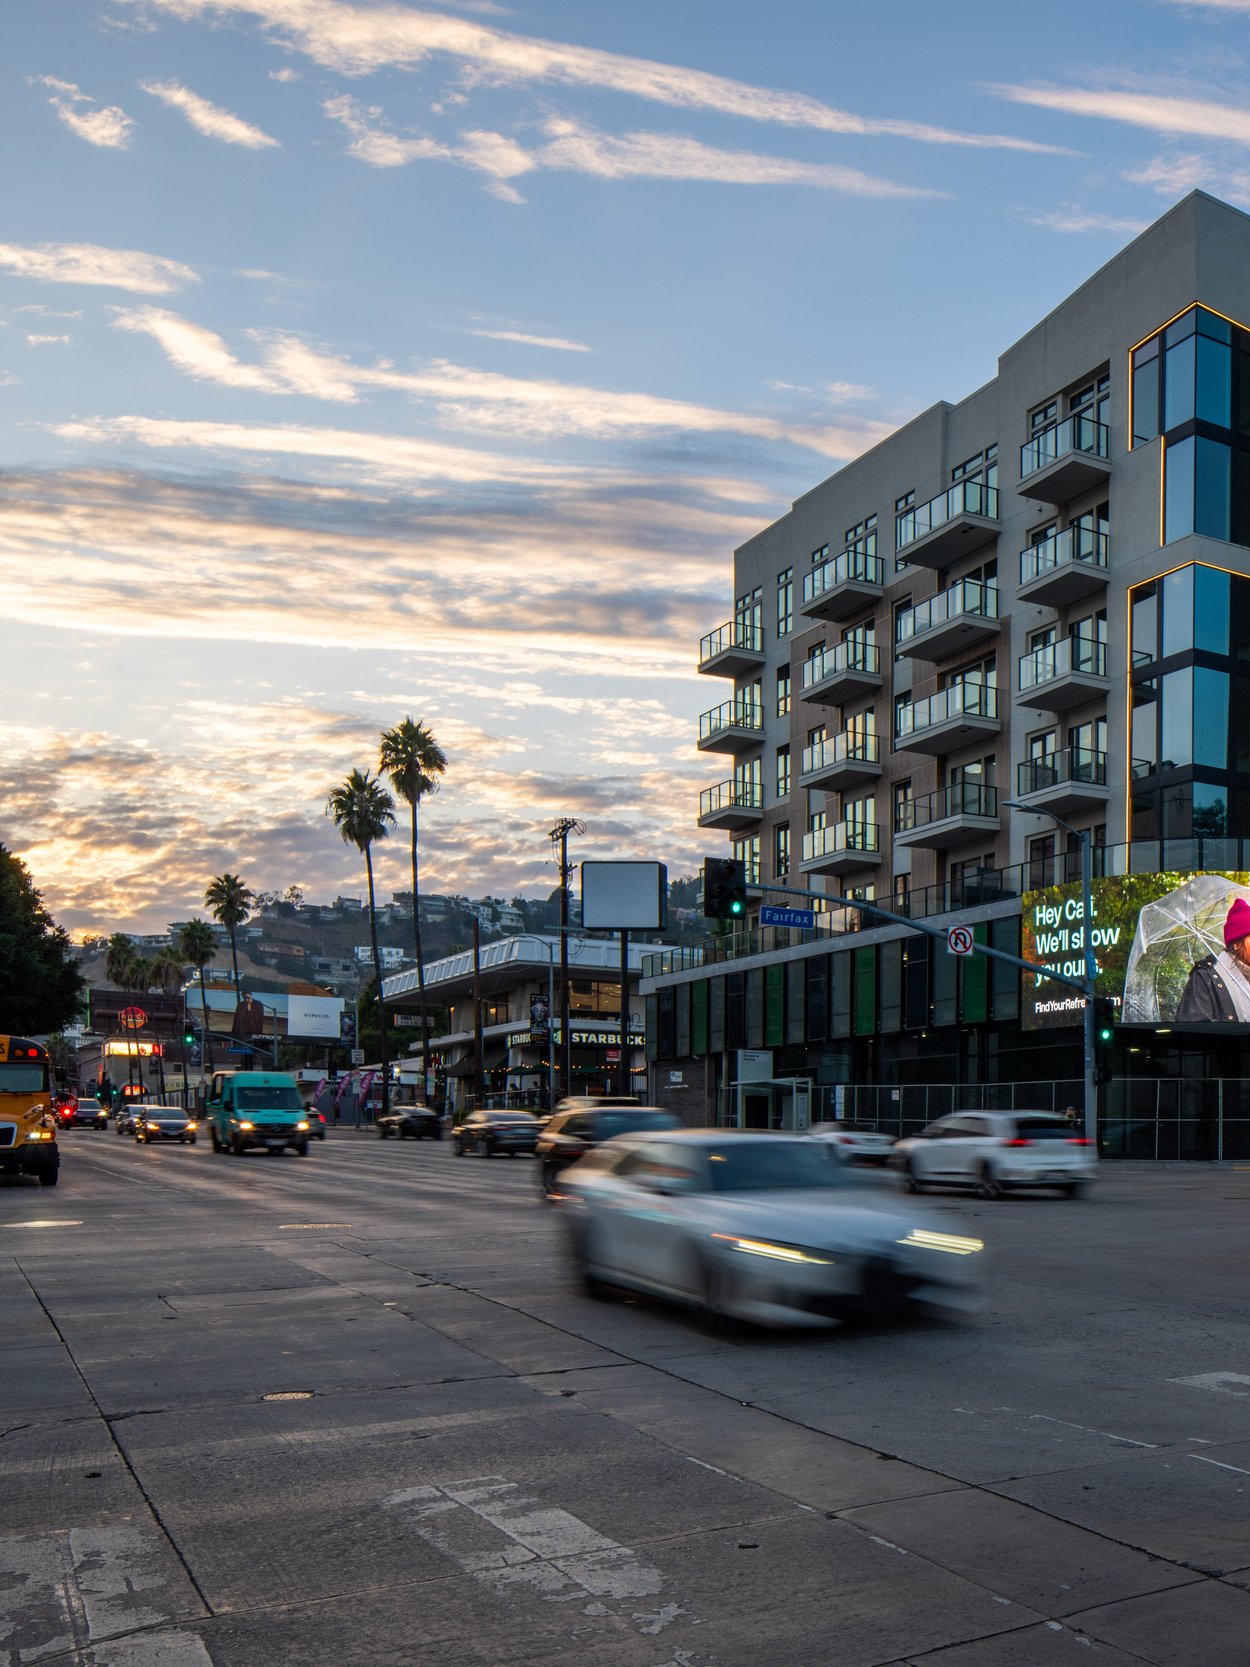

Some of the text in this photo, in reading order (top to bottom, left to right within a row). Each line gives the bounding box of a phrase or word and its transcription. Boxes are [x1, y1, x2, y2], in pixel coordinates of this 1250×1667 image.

[765, 910, 809, 924] Fairfax
[1035, 895, 1098, 929] Hey Cai.
[1035, 929, 1069, 955] We'll
